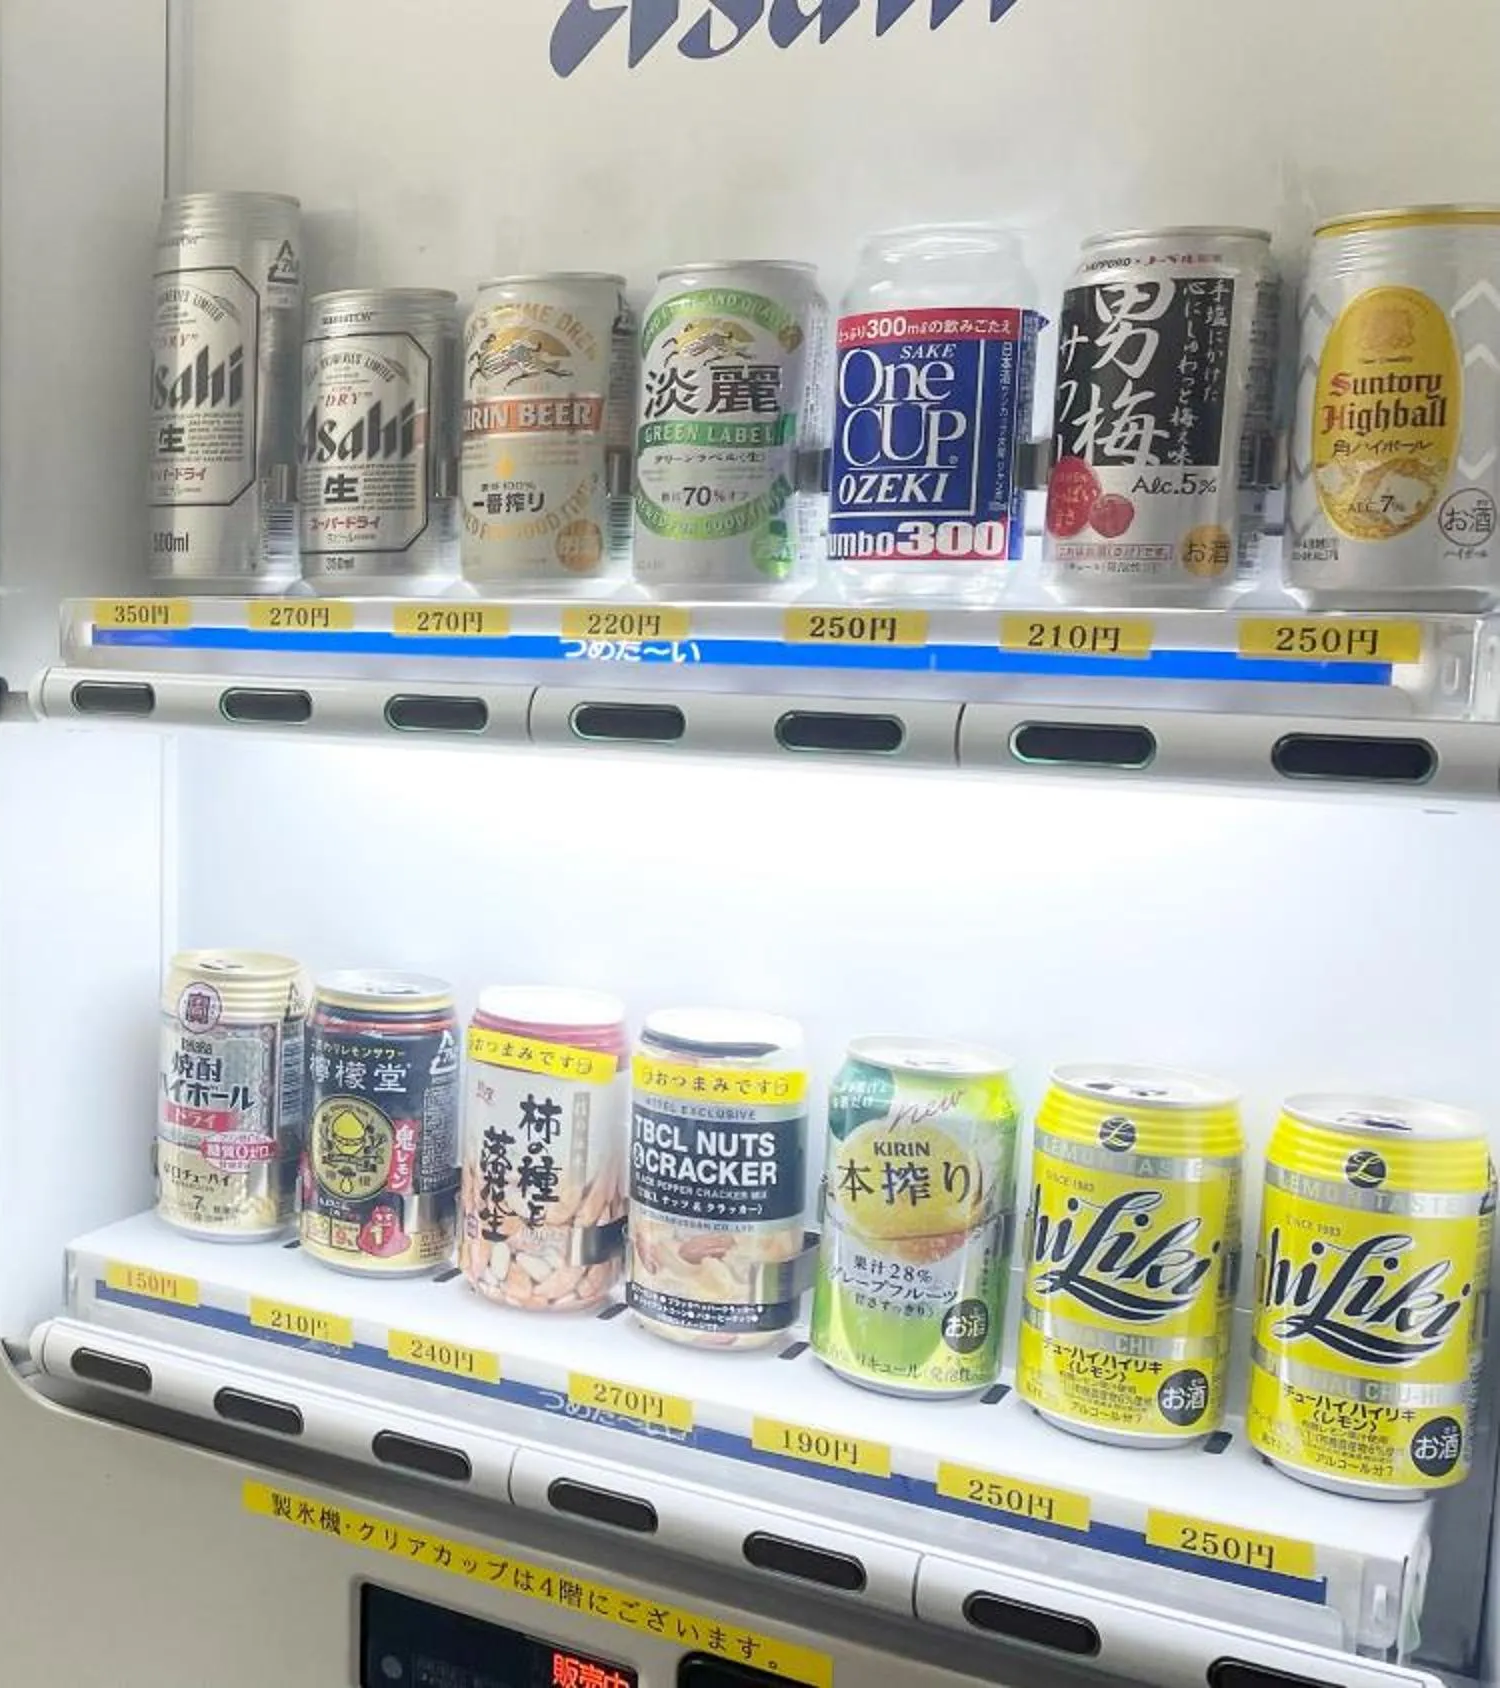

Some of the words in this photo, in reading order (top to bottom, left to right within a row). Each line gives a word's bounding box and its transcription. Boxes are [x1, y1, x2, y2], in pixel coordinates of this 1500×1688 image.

[900, 343, 957, 361] SAKE
[644, 364, 783, 419] 淡麗
[839, 348, 955, 407] One
[1328, 370, 1445, 400] Suntory
[518, 401, 594, 427] BEER
[1320, 397, 1448, 438] Highball
[158, 424, 186, 453] 生
[300, 398, 415, 464] Asahi
[644, 424, 700, 446] GREEN
[707, 423, 774, 444] LABEL
[842, 402, 967, 469] CUP
[324, 473, 359, 503] 生
[839, 473, 950, 506] OZEKI
[1444, 504, 1493, 533] お酒
[1186, 540, 1231, 565] お酒
[114, 604, 170, 626] 350円
[268, 606, 330, 628] 270円
[416, 610, 484, 633] 270円
[587, 612, 661, 636] 220円
[808, 615, 897, 642] 250円
[1027, 622, 1122, 653] 210円
[1274, 626, 1379, 657] 250円
[634, 1114, 689, 1152] TBCL
[697, 1131, 776, 1158] NUTS
[874, 1140, 932, 1158] KIRIN
[838, 1159, 971, 1207] 本搾り
[124, 1270, 179, 1299] 150円
[270, 1309, 329, 1339] 210円
[944, 1311, 988, 1339] お酒
[410, 1338, 474, 1373] 240円
[592, 1382, 666, 1419] 270円
[1161, 1384, 1207, 1412] お酒
[781, 1428, 859, 1466] 190円
[1414, 1431, 1461, 1464] お酒
[968, 1479, 1055, 1521] 250円
[1180, 1526, 1275, 1570] 250円
